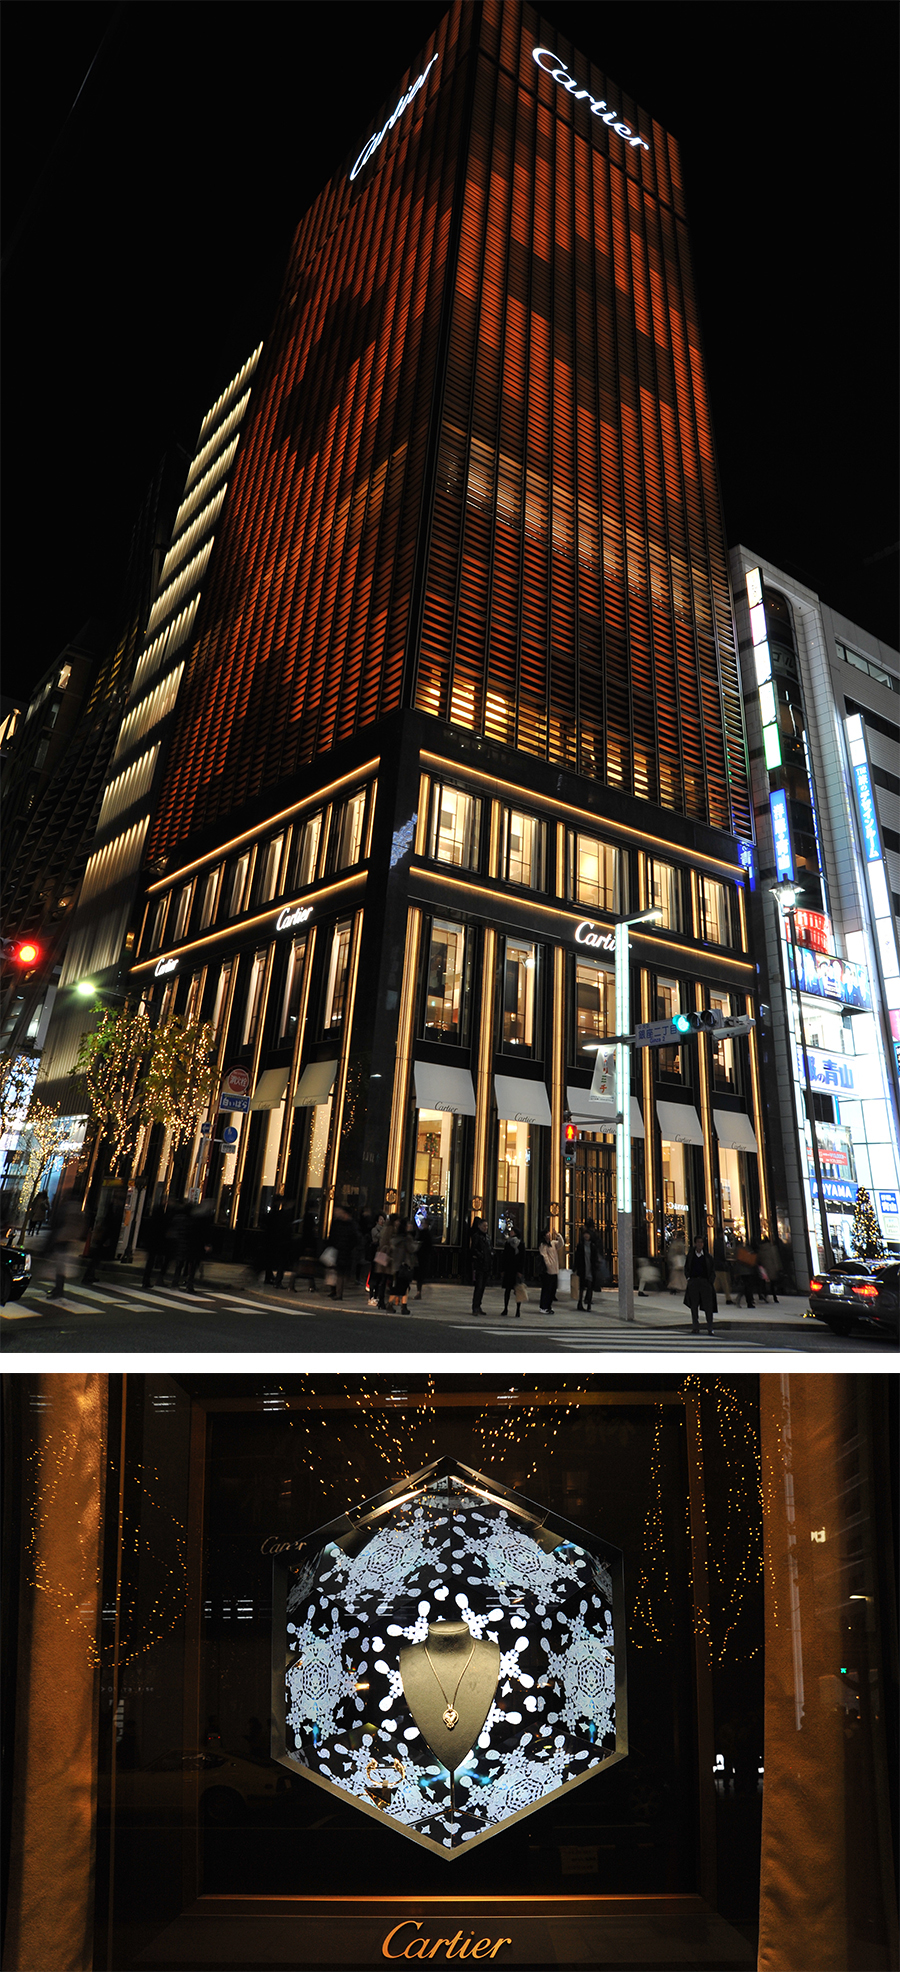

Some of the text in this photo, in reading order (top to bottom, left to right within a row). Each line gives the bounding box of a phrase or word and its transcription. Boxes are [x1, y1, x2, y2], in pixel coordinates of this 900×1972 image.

[532, 47, 650, 150] Cartier
[350, 52, 439, 181] Cartier
[276, 906, 314, 931] Cartier
[154, 957, 180, 977] Cartier
[638, 1024, 677, 1040] 銀座二丁目
[222, 1097, 248, 1109] 白いばら
[434, 1101, 459, 1113] Cartier
[513, 1112, 536, 1123] Cartier
[674, 1133, 692, 1143] Cartier
[730, 1142, 747, 1151] Cartier
[812, 1181, 853, 1198] AYAMA
[381, 1919, 513, 1960] Cartier
